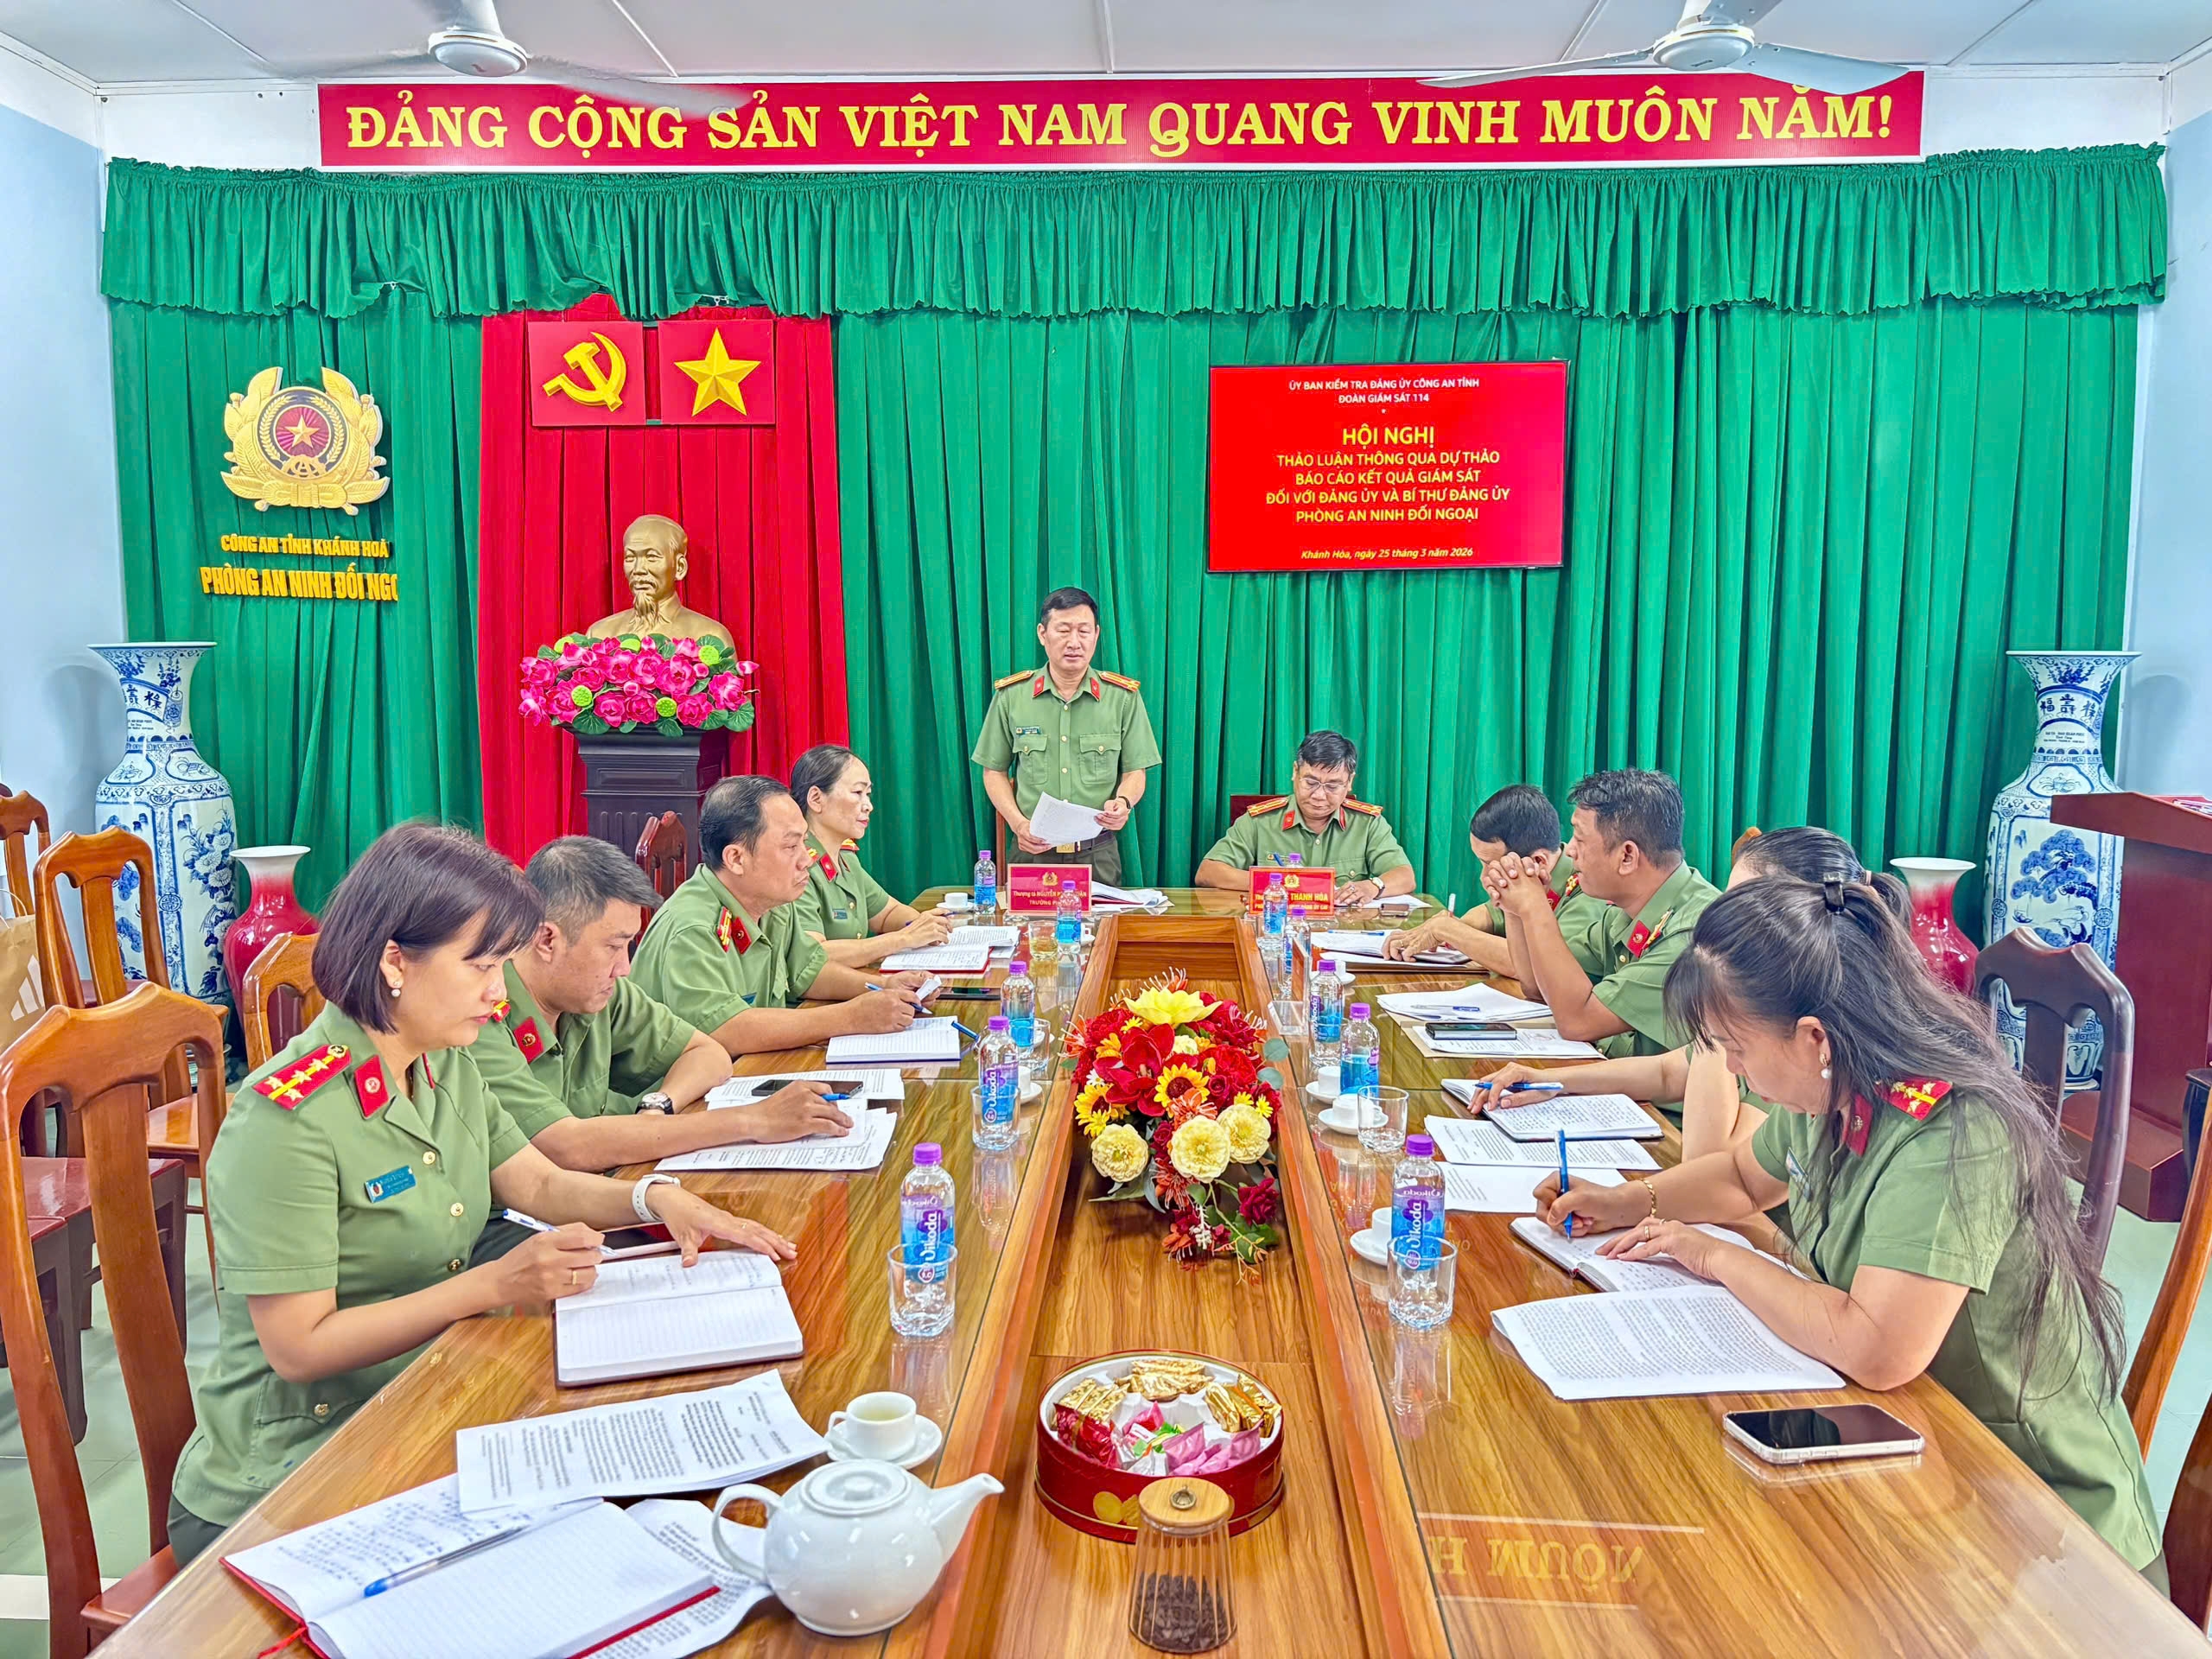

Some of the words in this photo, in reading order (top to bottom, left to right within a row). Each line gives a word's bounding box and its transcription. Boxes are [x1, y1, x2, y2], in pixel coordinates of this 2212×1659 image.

[346, 91, 505, 148] ĐẢNG
[529, 95, 687, 158] CỘNG
[709, 90, 820, 149] SẢN
[839, 94, 978, 157] VIỆT
[1000, 104, 1127, 145] NAM
[1149, 103, 1351, 157] QUANG
[1372, 101, 1520, 143] VINH
[1541, 87, 1717, 142] MUÔN
[1739, 86, 1891, 139] NĂM!
[1325, 378, 1348, 389] KIỂM
[1370, 378, 1396, 389] ĐẢNG
[1414, 378, 1440, 388] CÔNG
[1458, 377, 1478, 387] TỈNH
[1338, 394, 1365, 403] ĐOÀN
[1368, 393, 1391, 403] GIÁM
[1394, 392, 1410, 402] SÁT
[1343, 423, 1377, 449] HỘI
[1385, 427, 1433, 448] NGHỊ
[1277, 452, 1313, 466] THẢO
[1318, 452, 1352, 468] LUẬN
[1357, 451, 1403, 465] THÔNG
[1408, 453, 1436, 466] QUA
[1440, 450, 1460, 466] DỰ
[1463, 448, 1499, 463] THẢO
[1296, 471, 1323, 485] BÁO
[1327, 470, 1354, 484] CÁO
[1358, 468, 1382, 484] KẾT
[1386, 468, 1414, 485] QUẢ
[1418, 468, 1452, 483] GIÁM
[1457, 468, 1481, 482] SÁT
[1267, 489, 1289, 504] ĐỐI
[1294, 490, 1315, 503] VỚI
[1319, 489, 1357, 503] ĐẢNG
[1362, 488, 1378, 502] ỦY
[1382, 488, 1399, 501] VÀ
[1403, 487, 1416, 501] BÍ
[1419, 488, 1447, 501] THƯ
[1450, 486, 1488, 500] ĐẢNG
[1492, 486, 1510, 500] ỦY
[1297, 508, 1344, 522] PHÒNG
[1348, 510, 1366, 521] AN
[1370, 510, 1404, 520] NINH
[1408, 505, 1431, 520] ĐỐI
[1436, 508, 1478, 522] NGOẠI
[221, 533, 259, 552] CÔNG
[259, 537, 280, 553] AN
[280, 533, 314, 555] TỈNH
[315, 536, 360, 556] KHÁNH
[1355, 550, 1376, 560] ngày
[1392, 550, 1419, 559] tháng
[1450, 548, 1472, 556] 2026
[200, 563, 260, 596] PHÒNG
[261, 569, 289, 596] AN
[289, 571, 334, 598] NINH
[334, 563, 365, 600] ĐỐI
